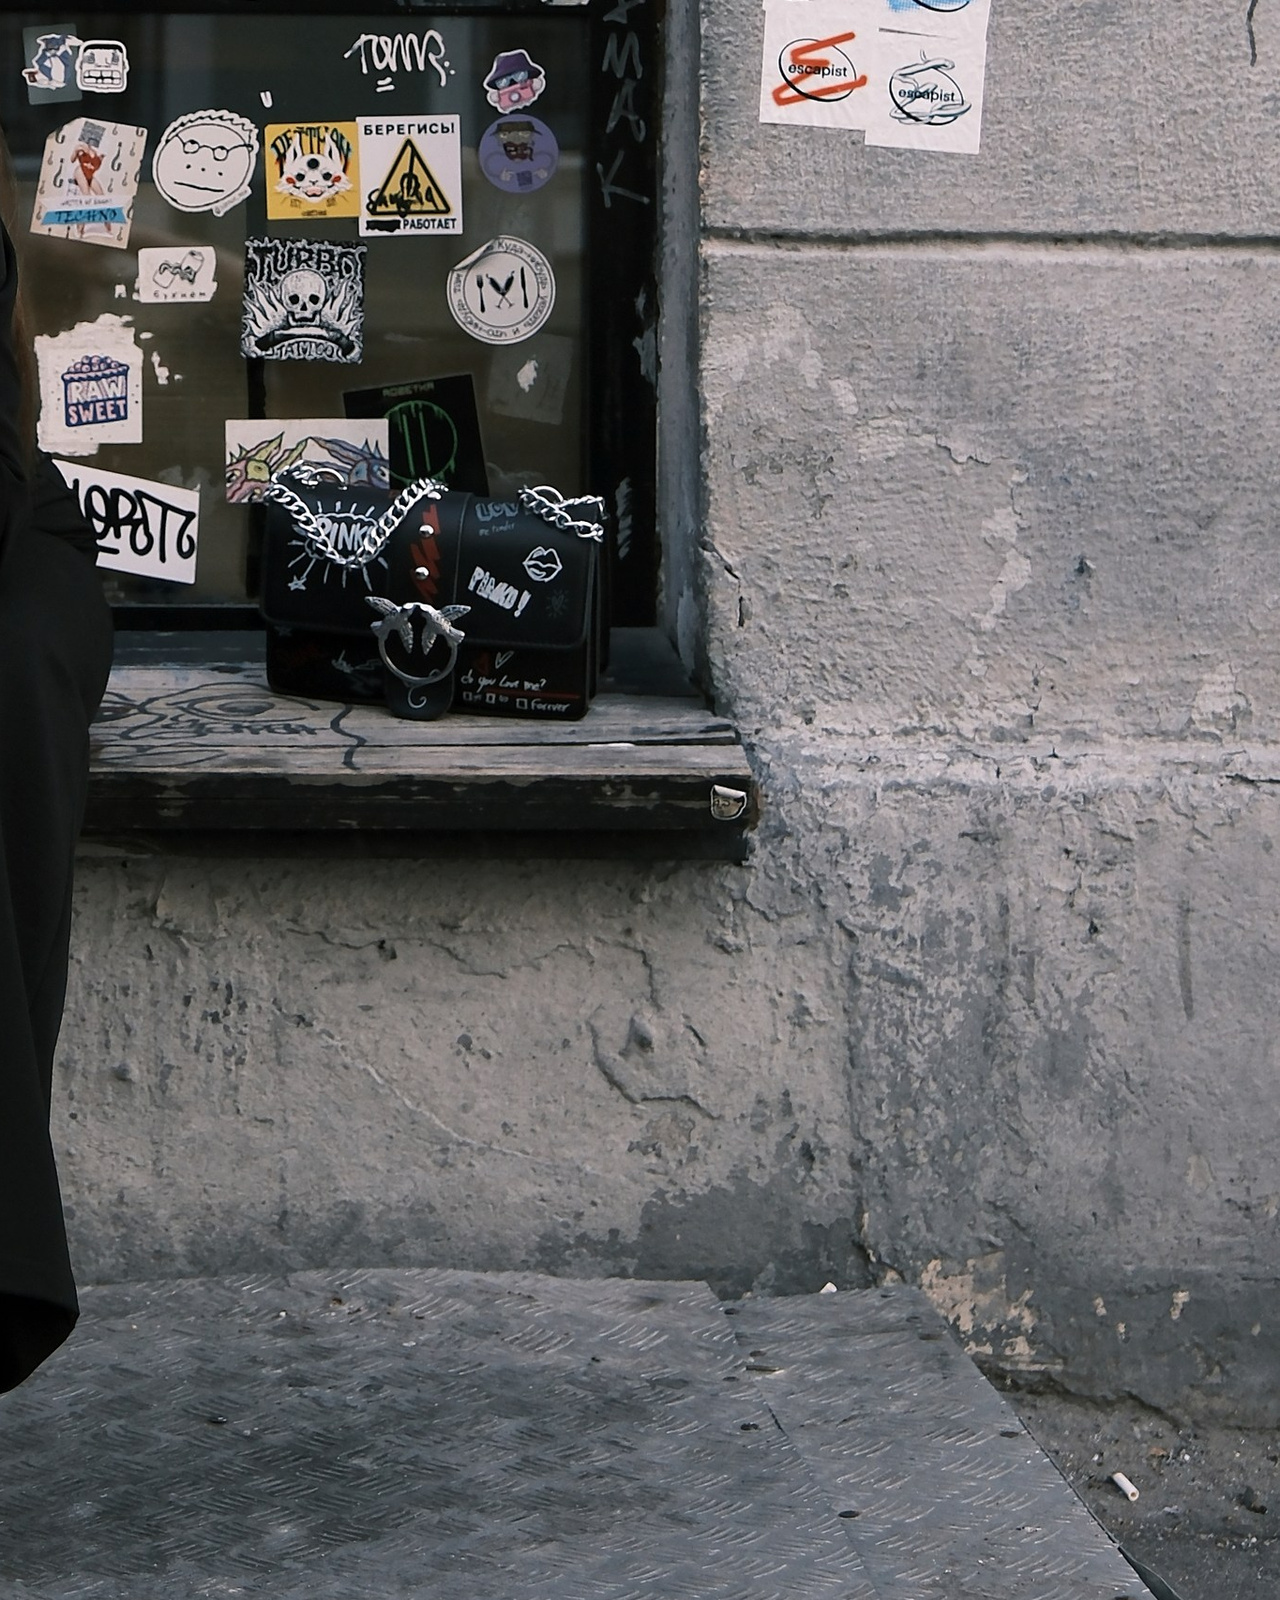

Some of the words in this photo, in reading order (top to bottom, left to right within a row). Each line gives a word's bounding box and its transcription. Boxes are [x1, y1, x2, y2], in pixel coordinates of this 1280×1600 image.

[788, 63, 848, 79] escapist
[363, 122, 455, 136] БЕРЕГИСЬ!
[403, 218, 457, 230] РАБОТАЕТ
[70, 377, 127, 403] RAW
[67, 399, 128, 426] SWEET
[477, 677, 497, 694] you
